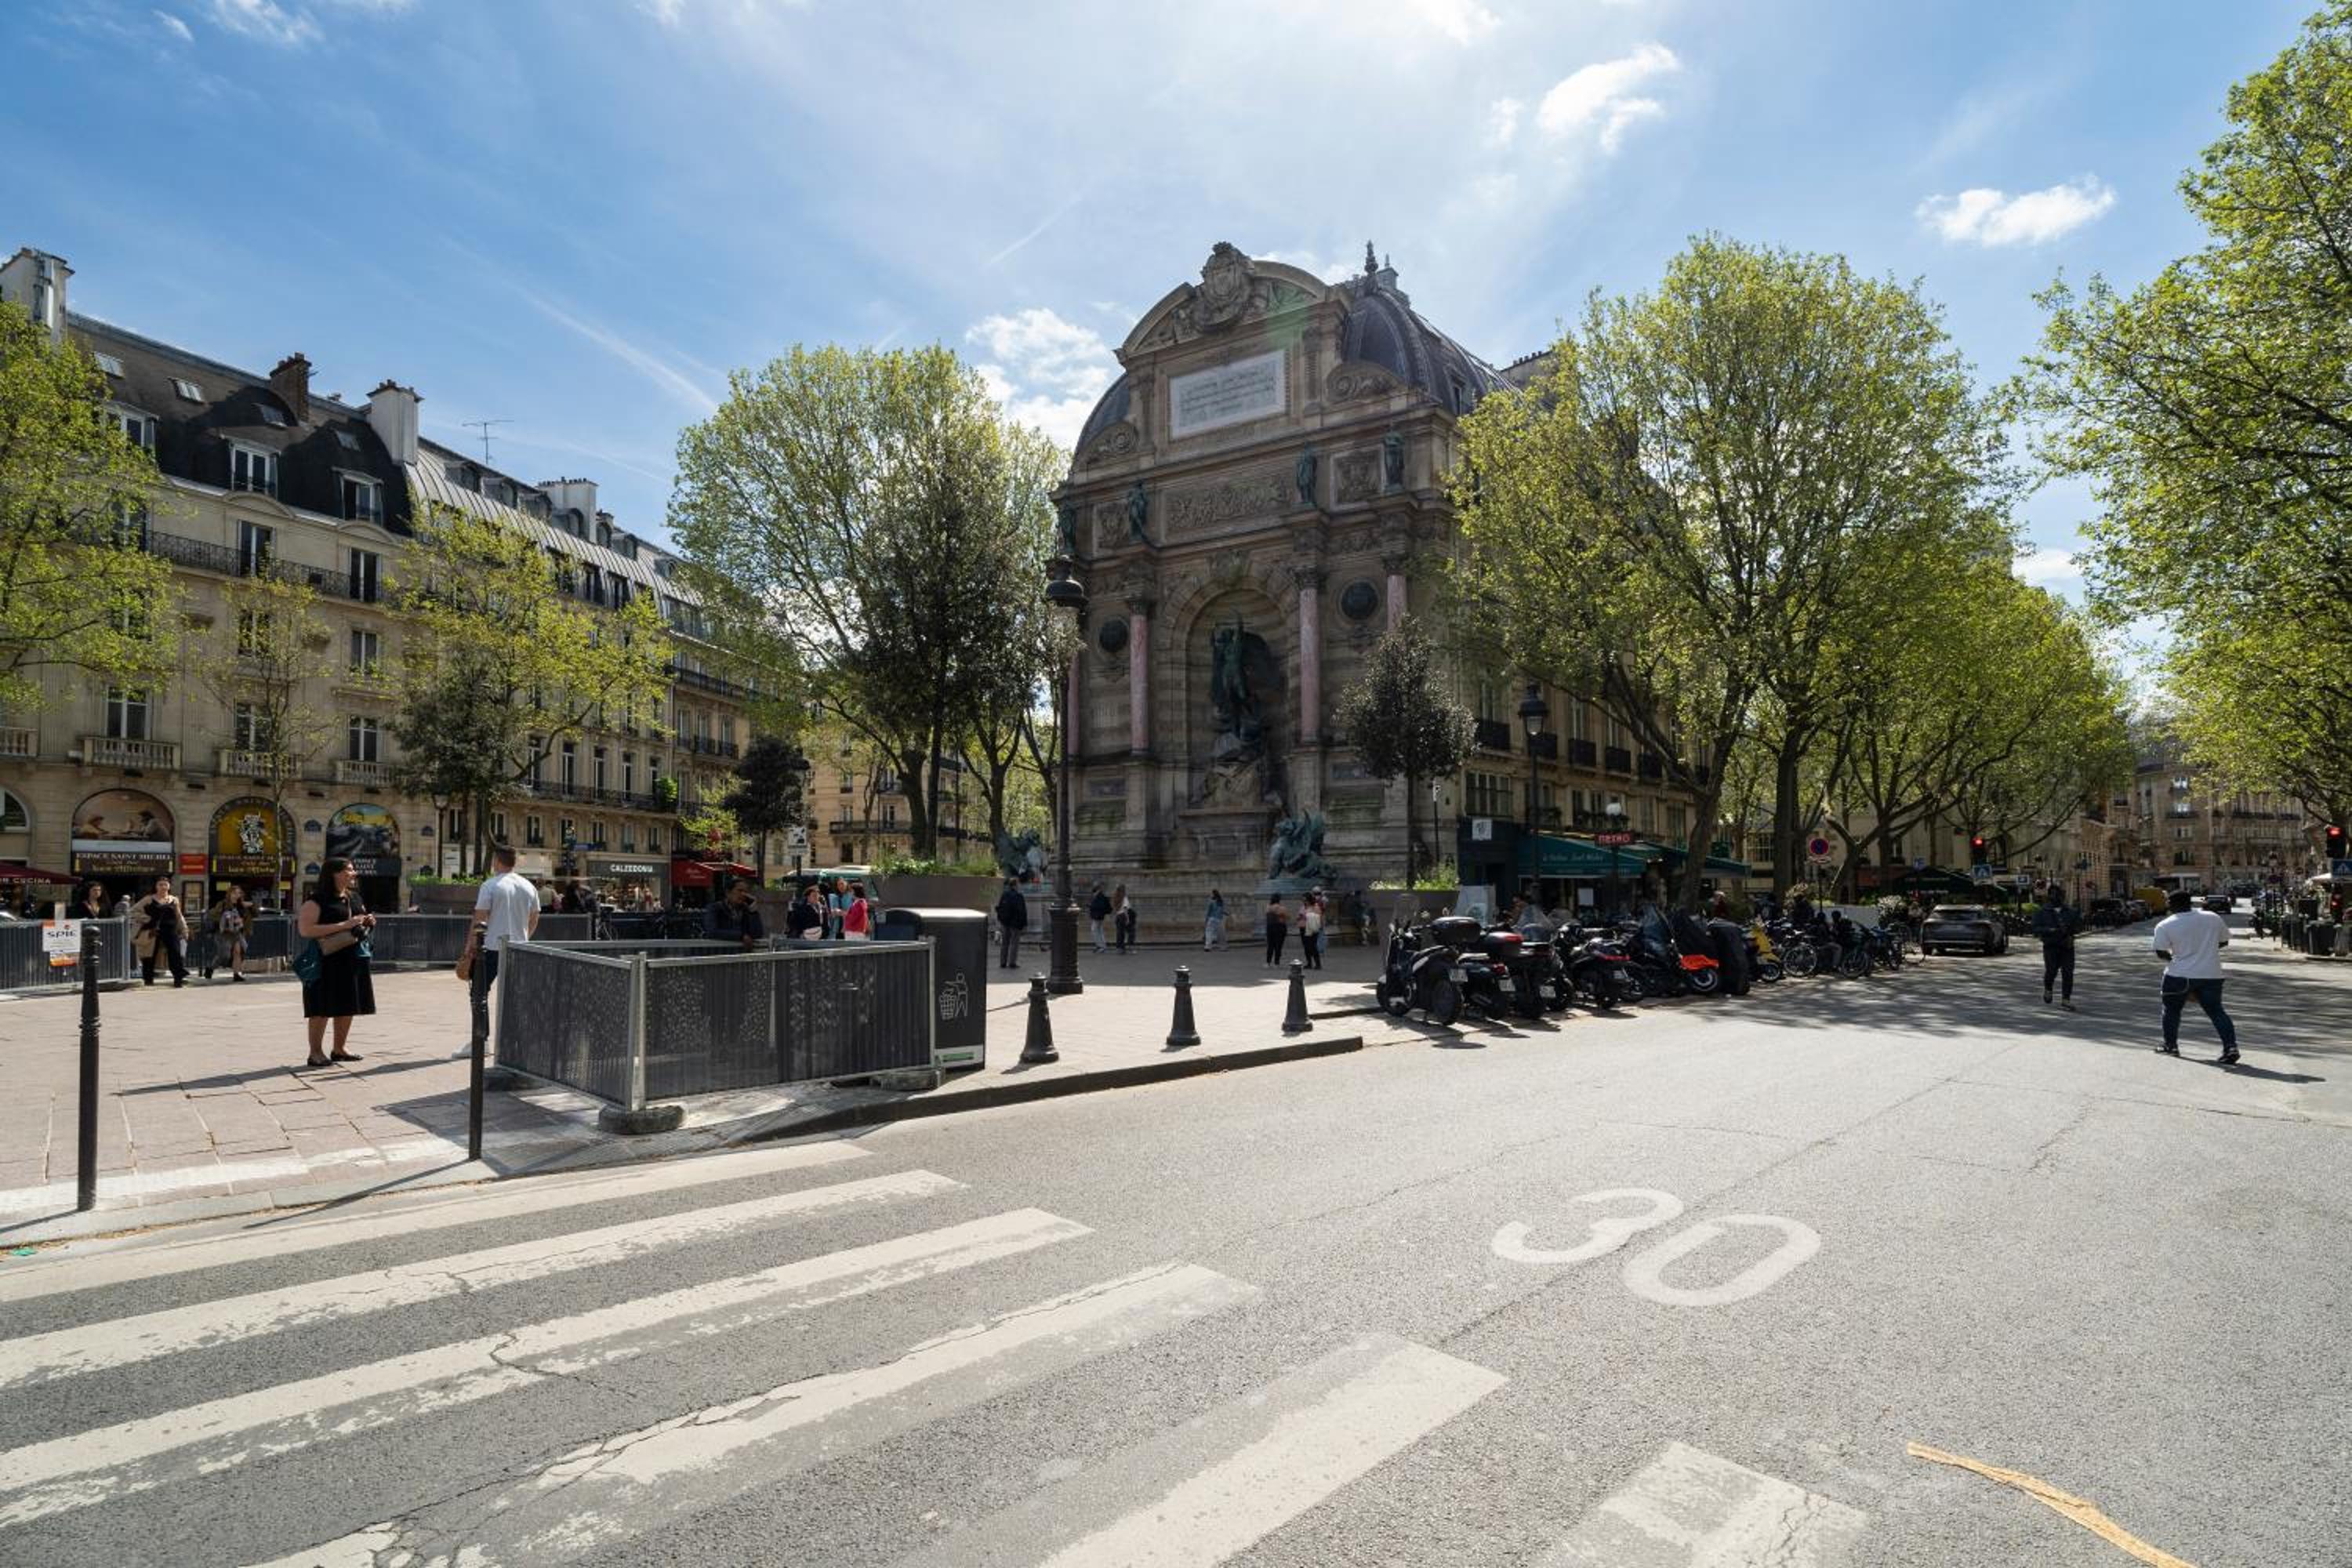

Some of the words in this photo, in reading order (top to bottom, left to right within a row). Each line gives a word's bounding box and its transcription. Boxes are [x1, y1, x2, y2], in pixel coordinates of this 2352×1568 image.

[610, 863, 653, 873] CALZEDONIA
[47, 930, 76, 938] SPIE
[1491, 1187, 1821, 1307] 30
